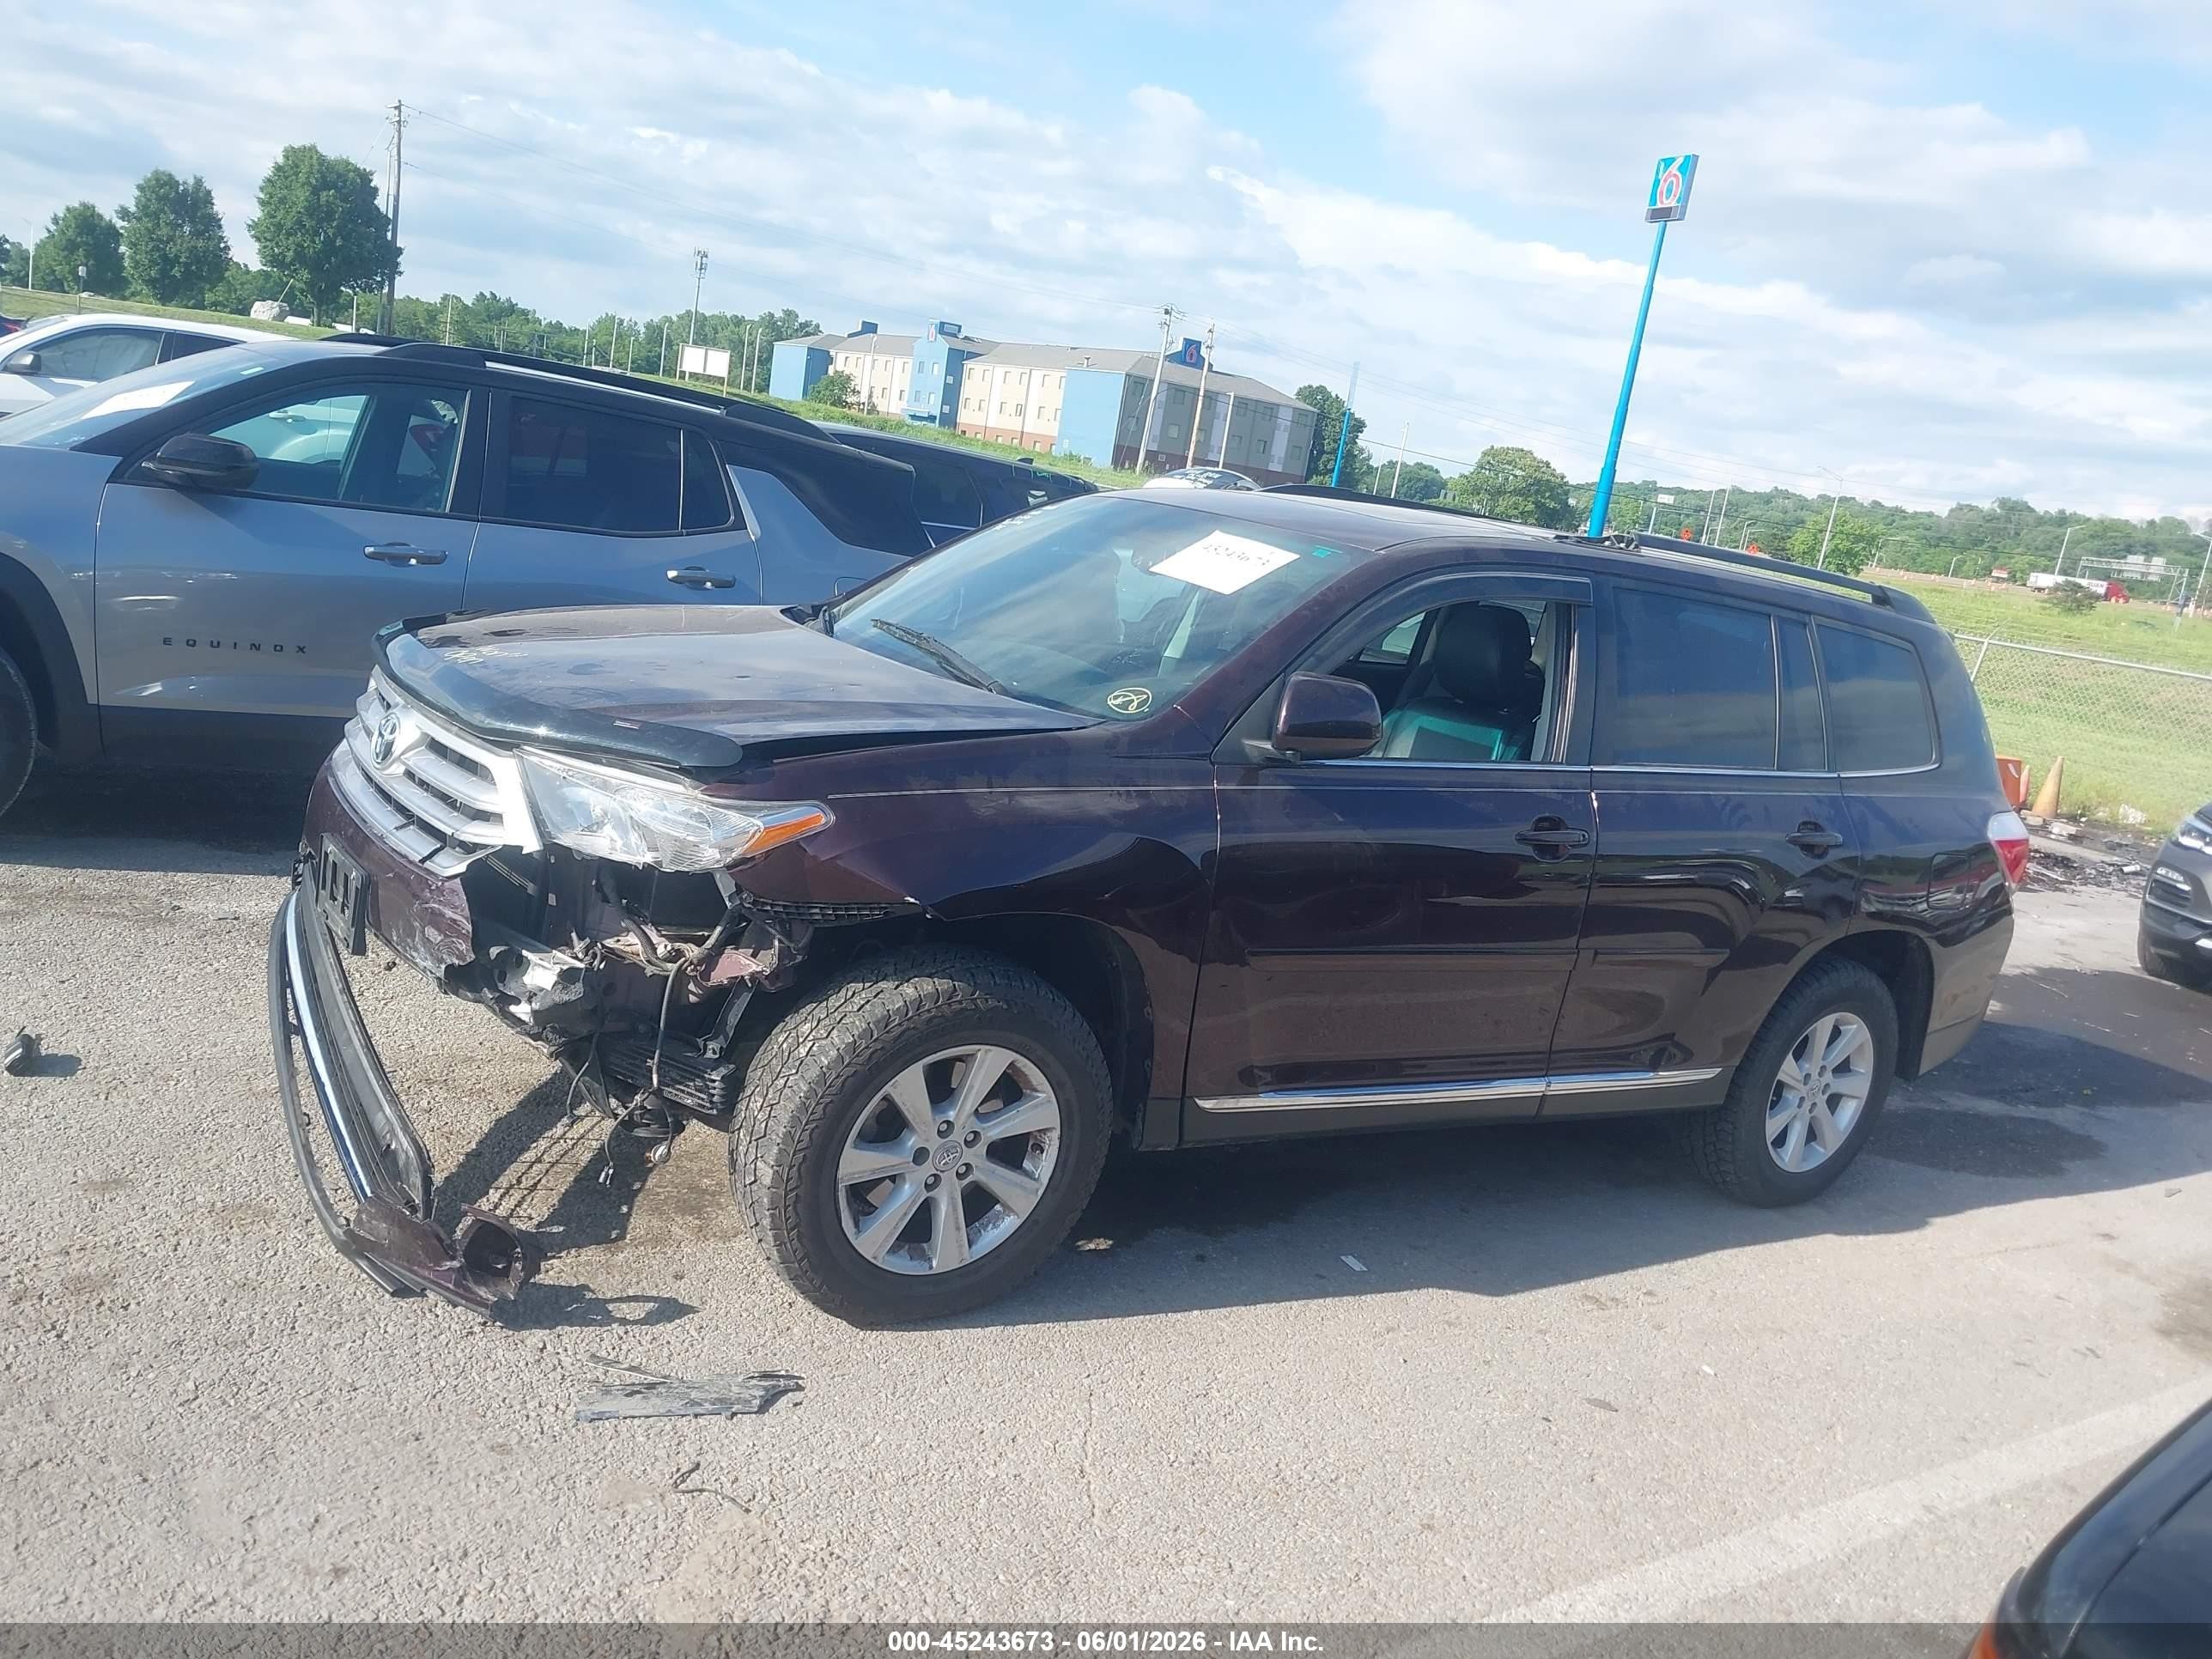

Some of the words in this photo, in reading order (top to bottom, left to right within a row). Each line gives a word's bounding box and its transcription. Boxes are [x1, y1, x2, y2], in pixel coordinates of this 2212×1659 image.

[1656, 156, 1684, 207] 6
[1185, 343, 1198, 364] 6
[162, 637, 307, 654] EQUINOX
